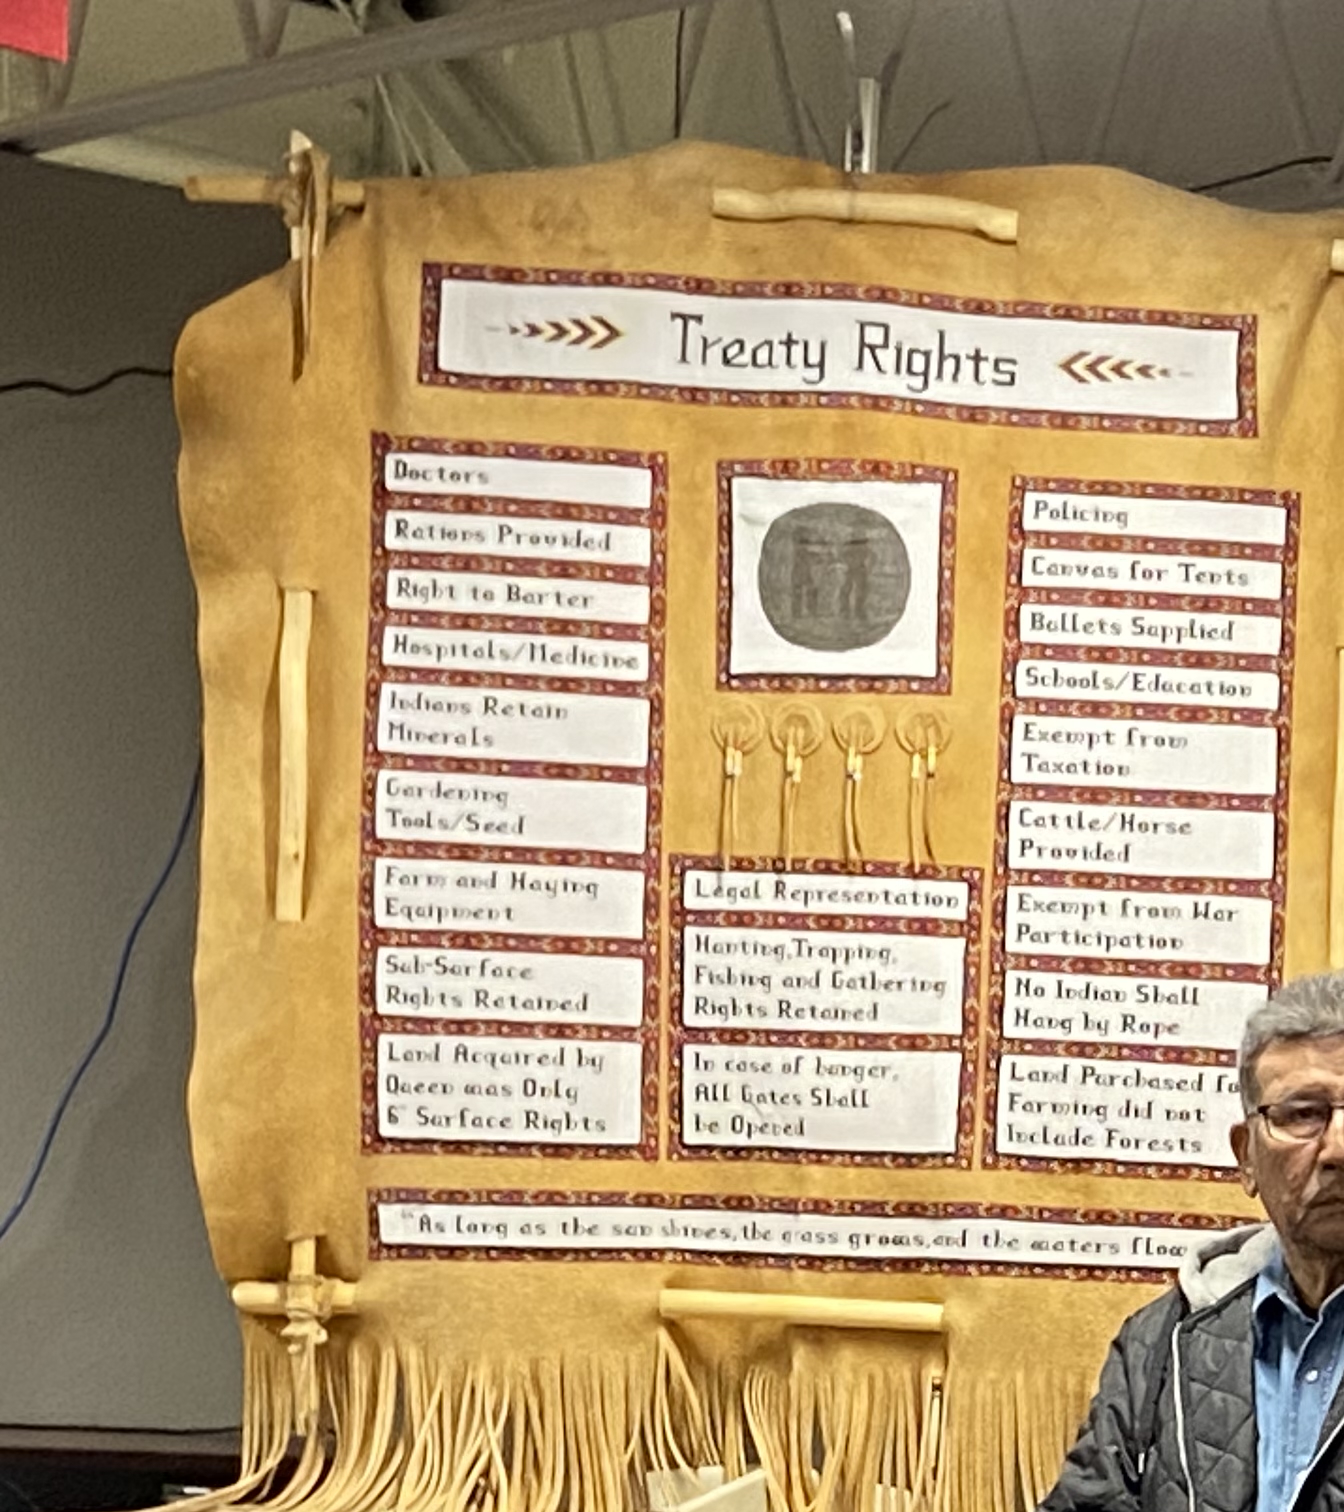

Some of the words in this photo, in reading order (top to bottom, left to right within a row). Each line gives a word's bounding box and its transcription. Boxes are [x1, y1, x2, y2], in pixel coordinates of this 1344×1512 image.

[670, 312, 827, 383] Treaty
[856, 320, 1018, 392] Rights
[393, 462, 489, 486] Doctors
[1033, 500, 1129, 529] Policing
[394, 520, 486, 545] Rations
[498, 525, 611, 552] Provided
[1031, 555, 1119, 580] Canvas
[1128, 557, 1169, 582] for
[1177, 562, 1250, 588] Tents
[396, 577, 456, 606] Right
[470, 583, 496, 601] to
[506, 585, 595, 610] Barter
[1030, 612, 1122, 637] Bullets
[1130, 616, 1235, 645] Supplied
[1025, 667, 1252, 698] Schools/Education
[389, 691, 472, 716] Indians
[483, 697, 568, 720] Retain
[387, 722, 495, 748] Minerals
[1022, 722, 1116, 750] Exempt
[1125, 727, 1188, 750] from
[1021, 751, 1130, 778] Taxation
[386, 779, 510, 805] Gardening
[1018, 807, 1192, 836] Cattle/Horse
[1018, 838, 1130, 864] Provided
[385, 866, 447, 892] Farm
[456, 870, 497, 892] and
[511, 872, 601, 900] Haying
[695, 878, 762, 904] Legal
[774, 880, 961, 912] Representation
[385, 897, 515, 924] Equipment
[1017, 892, 1109, 920] Exempt
[1119, 897, 1182, 920] from
[1190, 901, 1240, 923] War
[1015, 923, 1184, 953] Participation
[694, 964, 772, 994] Fishing
[783, 970, 820, 990] and
[830, 970, 948, 998] Gathering
[1014, 978, 1045, 998] No
[1055, 980, 1127, 1002] Indian
[1135, 984, 1199, 1007] Shall
[386, 986, 464, 1013] Rights
[475, 989, 590, 1014] Retained
[694, 998, 769, 1022] Rights
[777, 999, 880, 1023] Retained
[1013, 1008, 1073, 1033] Hang
[1082, 1011, 1110, 1038] by
[1119, 1013, 1181, 1038] Rope
[387, 1042, 441, 1066] Land
[454, 1044, 567, 1071] Acquired
[577, 1047, 605, 1074] by
[694, 1053, 716, 1074] In
[724, 1057, 774, 1075] case
[780, 1054, 806, 1076] of
[386, 1076, 456, 1101] Queen
[522, 1078, 580, 1105] Only
[1009, 1061, 1069, 1085] Land
[1080, 1064, 1203, 1093] Purchased
[1214, 1071, 1240, 1093] fo
[694, 1083, 732, 1104] All
[741, 1084, 802, 1107] Gates
[810, 1087, 870, 1110] Shall
[1008, 1092, 1108, 1122] Farming
[1117, 1095, 1153, 1120] did
[1164, 1102, 1207, 1123] not
[416, 1104, 514, 1131] Surface
[524, 1109, 608, 1136] Rights
[694, 1115, 720, 1136] be
[730, 1115, 807, 1139] Opened
[1007, 1124, 1094, 1148] Include
[1104, 1128, 1203, 1153] Forests
[455, 1215, 508, 1240] long
[519, 1220, 546, 1236] as
[561, 1215, 601, 1237] the
[612, 1221, 653, 1238] sun
[982, 1230, 1020, 1250] the
[1131, 1238, 1188, 1257] flow
